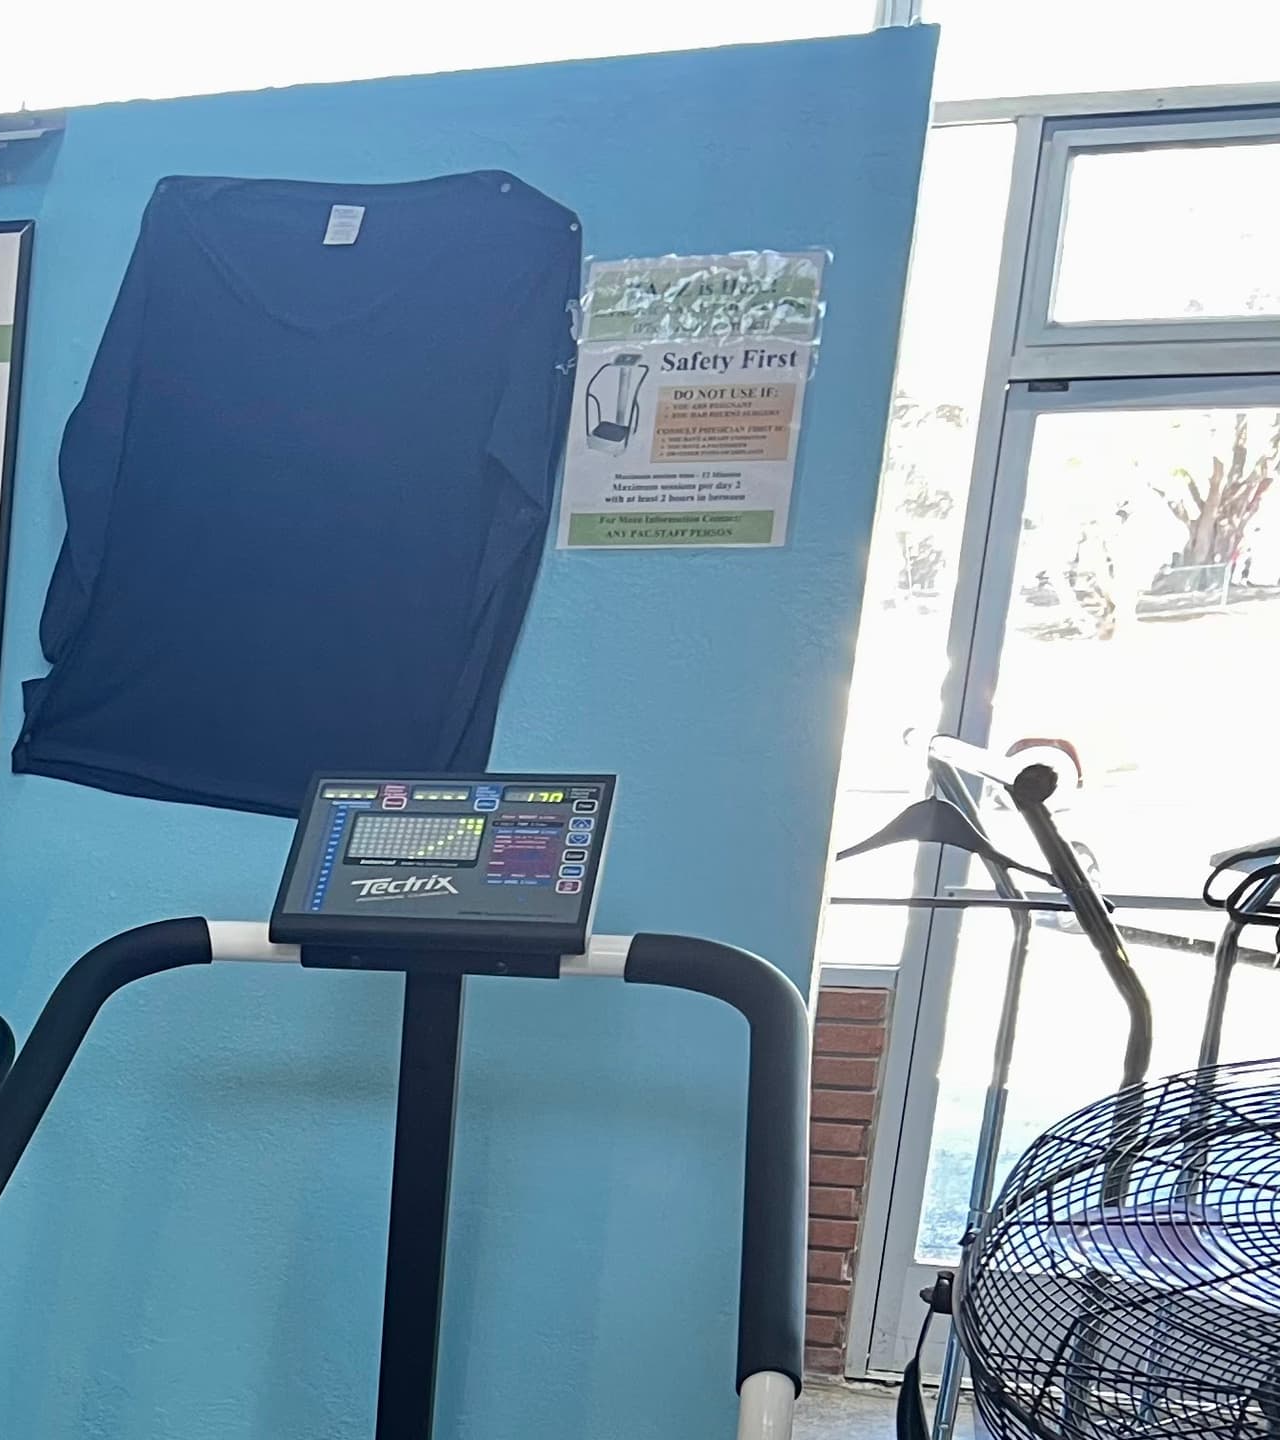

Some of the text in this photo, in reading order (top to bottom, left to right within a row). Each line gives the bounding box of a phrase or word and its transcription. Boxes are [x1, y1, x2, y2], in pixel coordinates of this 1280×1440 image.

[660, 349, 799, 374] Safety First
[673, 389, 694, 401] DO
[698, 388, 728, 400] NOT
[730, 387, 758, 399] USE
[350, 874, 460, 896] Tectrix
